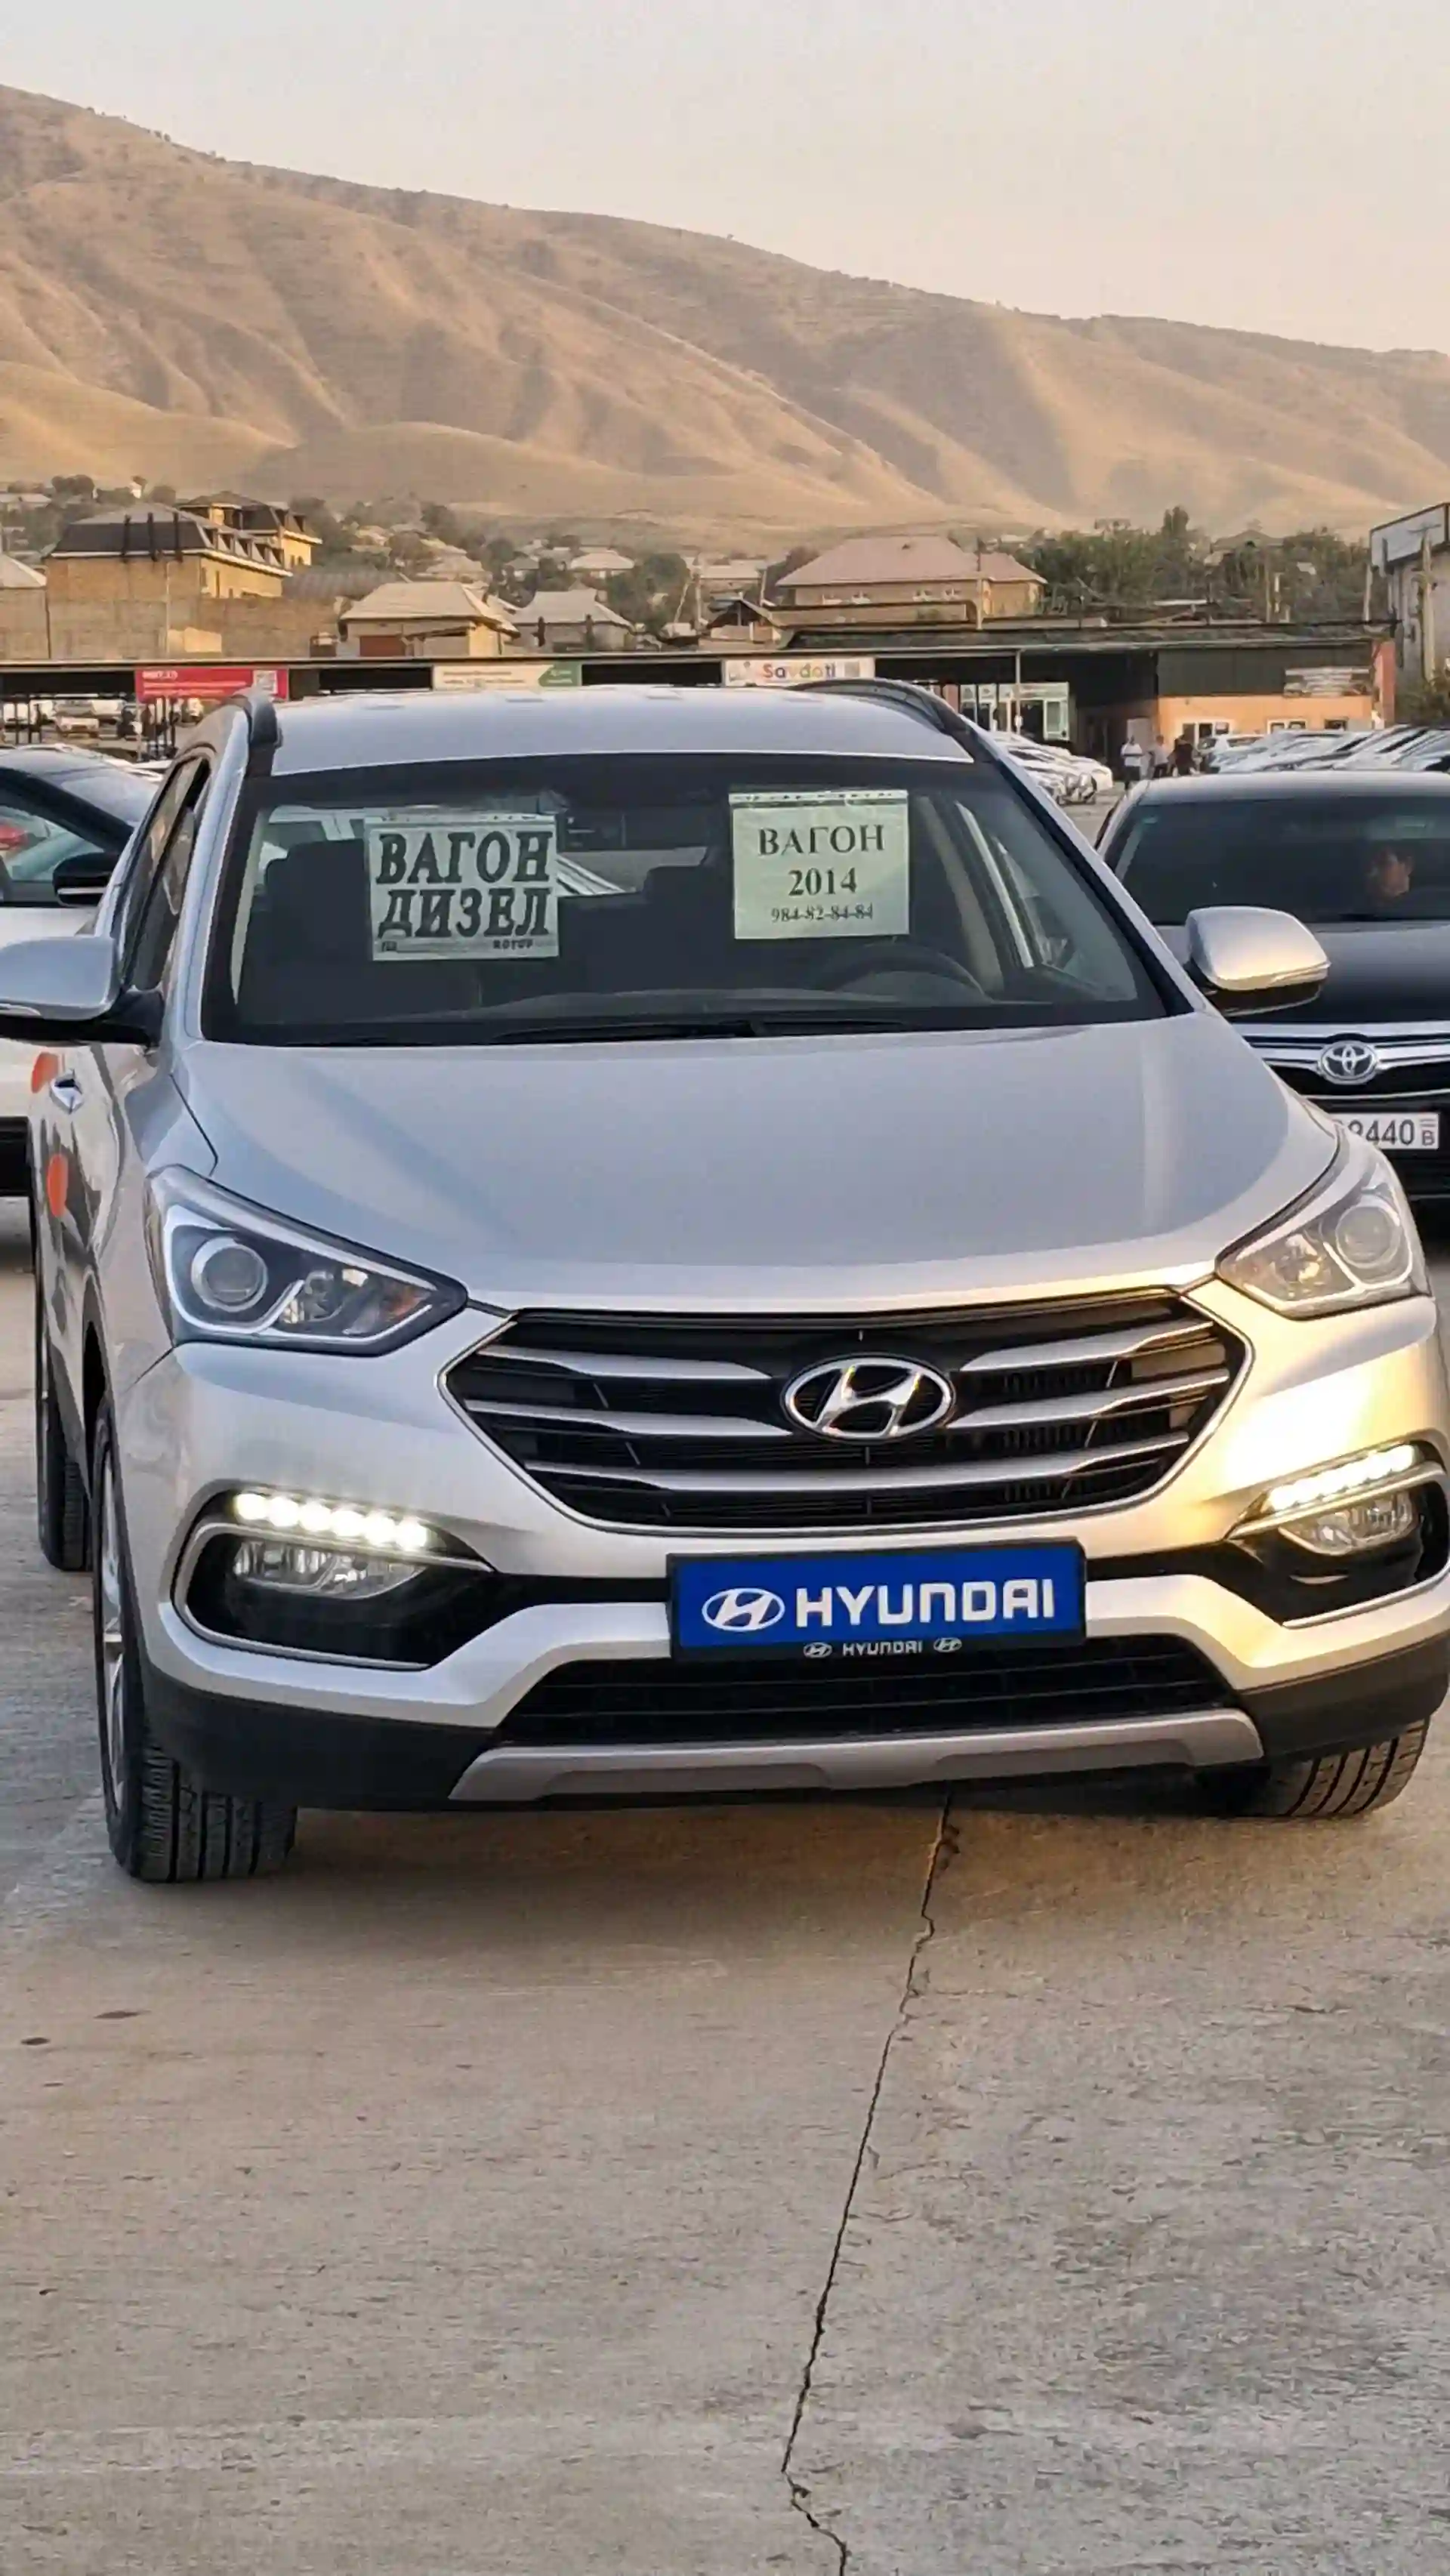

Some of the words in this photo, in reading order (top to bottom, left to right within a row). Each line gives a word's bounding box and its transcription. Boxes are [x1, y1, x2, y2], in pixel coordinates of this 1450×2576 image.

[758, 825, 884, 856] ВАГОН
[376, 831, 553, 884] ВАГОН
[788, 868, 857, 896] 2014
[378, 887, 551, 937] ДИЗЕЛ
[1332, 1119, 1415, 1145] 9440
[796, 1579, 1054, 1627] HYUNDAI
[842, 1640, 923, 1656] HYUNDAI
